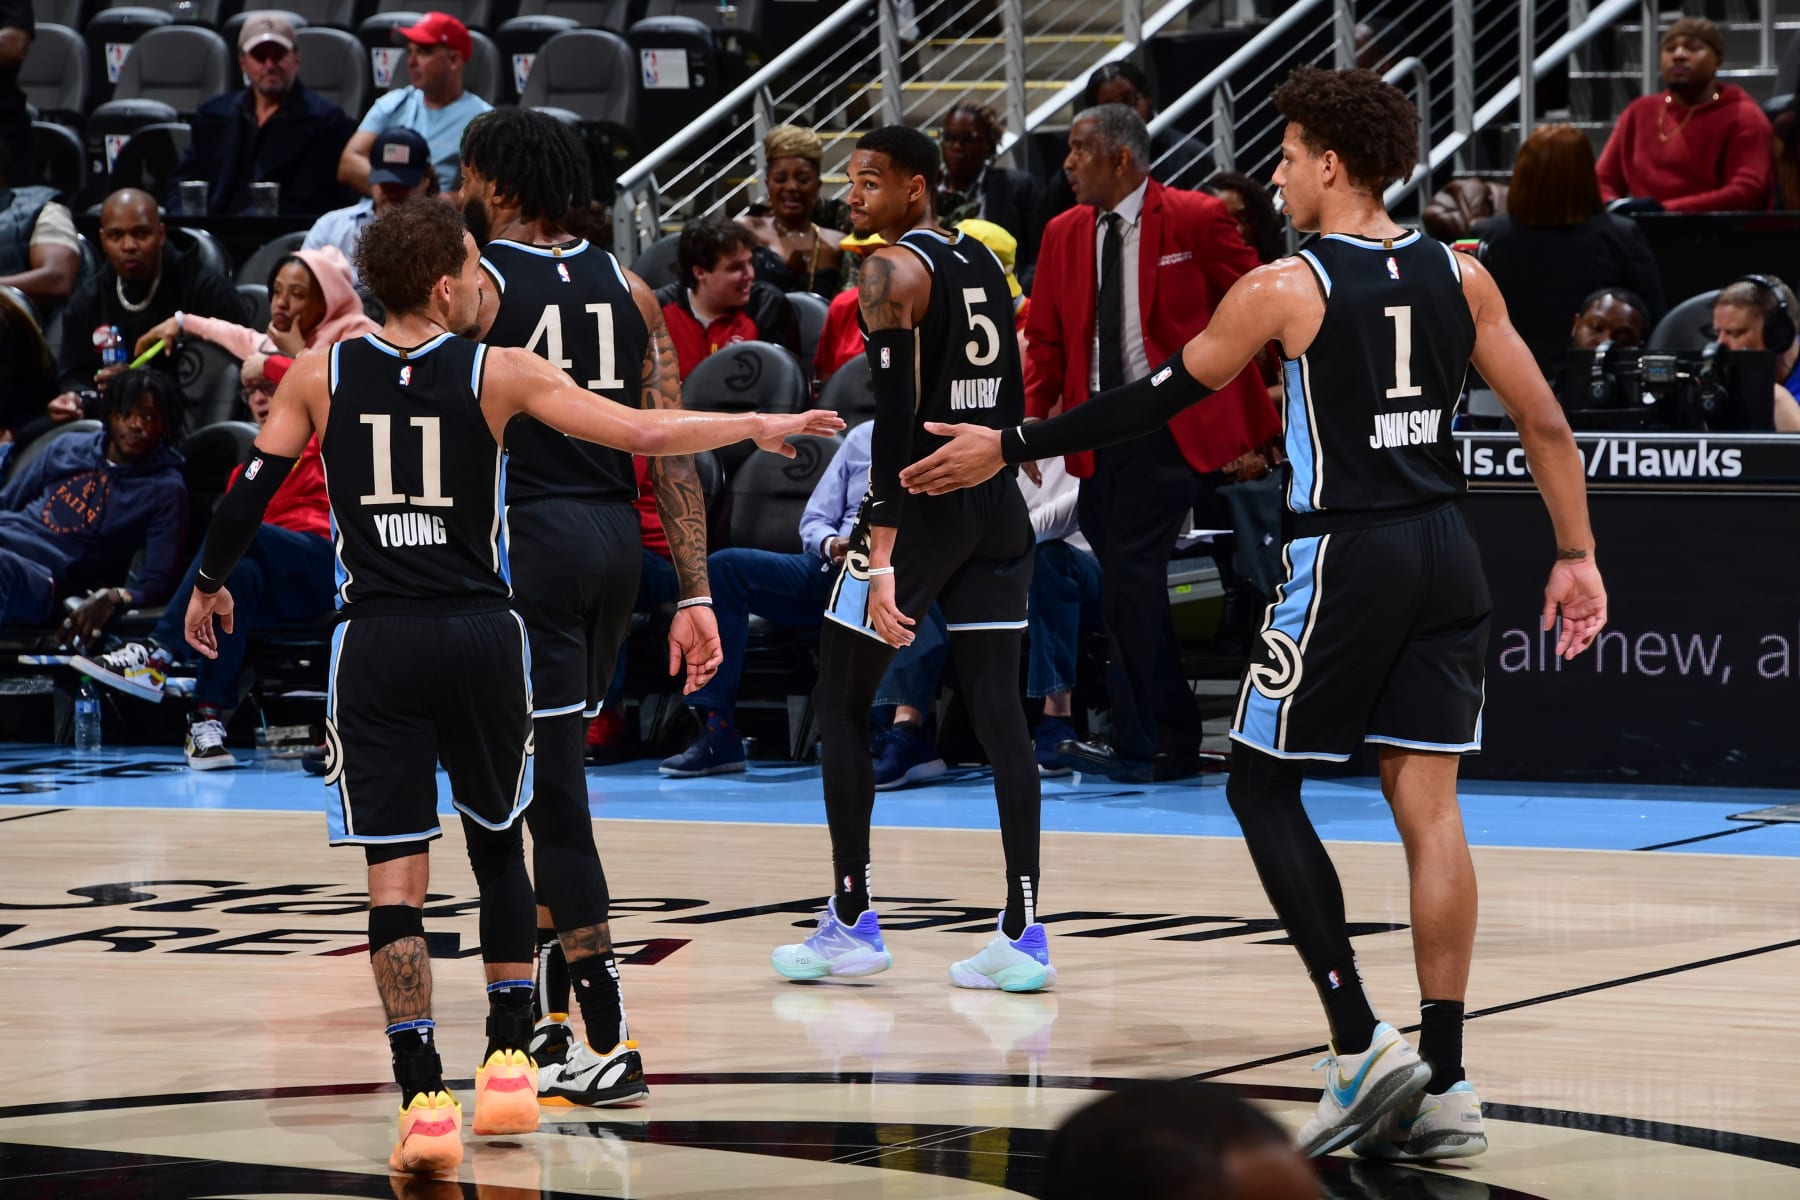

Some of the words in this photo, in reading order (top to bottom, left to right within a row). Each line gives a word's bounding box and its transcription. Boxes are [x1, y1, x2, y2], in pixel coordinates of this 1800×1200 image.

[524, 303, 624, 389] 41
[962, 287, 1000, 366] 5
[1384, 305, 1422, 399] 1
[359, 413, 453, 507] 11
[373, 512, 447, 548] YOUNG
[1499, 614, 1562, 673] all
[1596, 630, 1731, 685] new,
[1757, 619, 1800, 680] a
